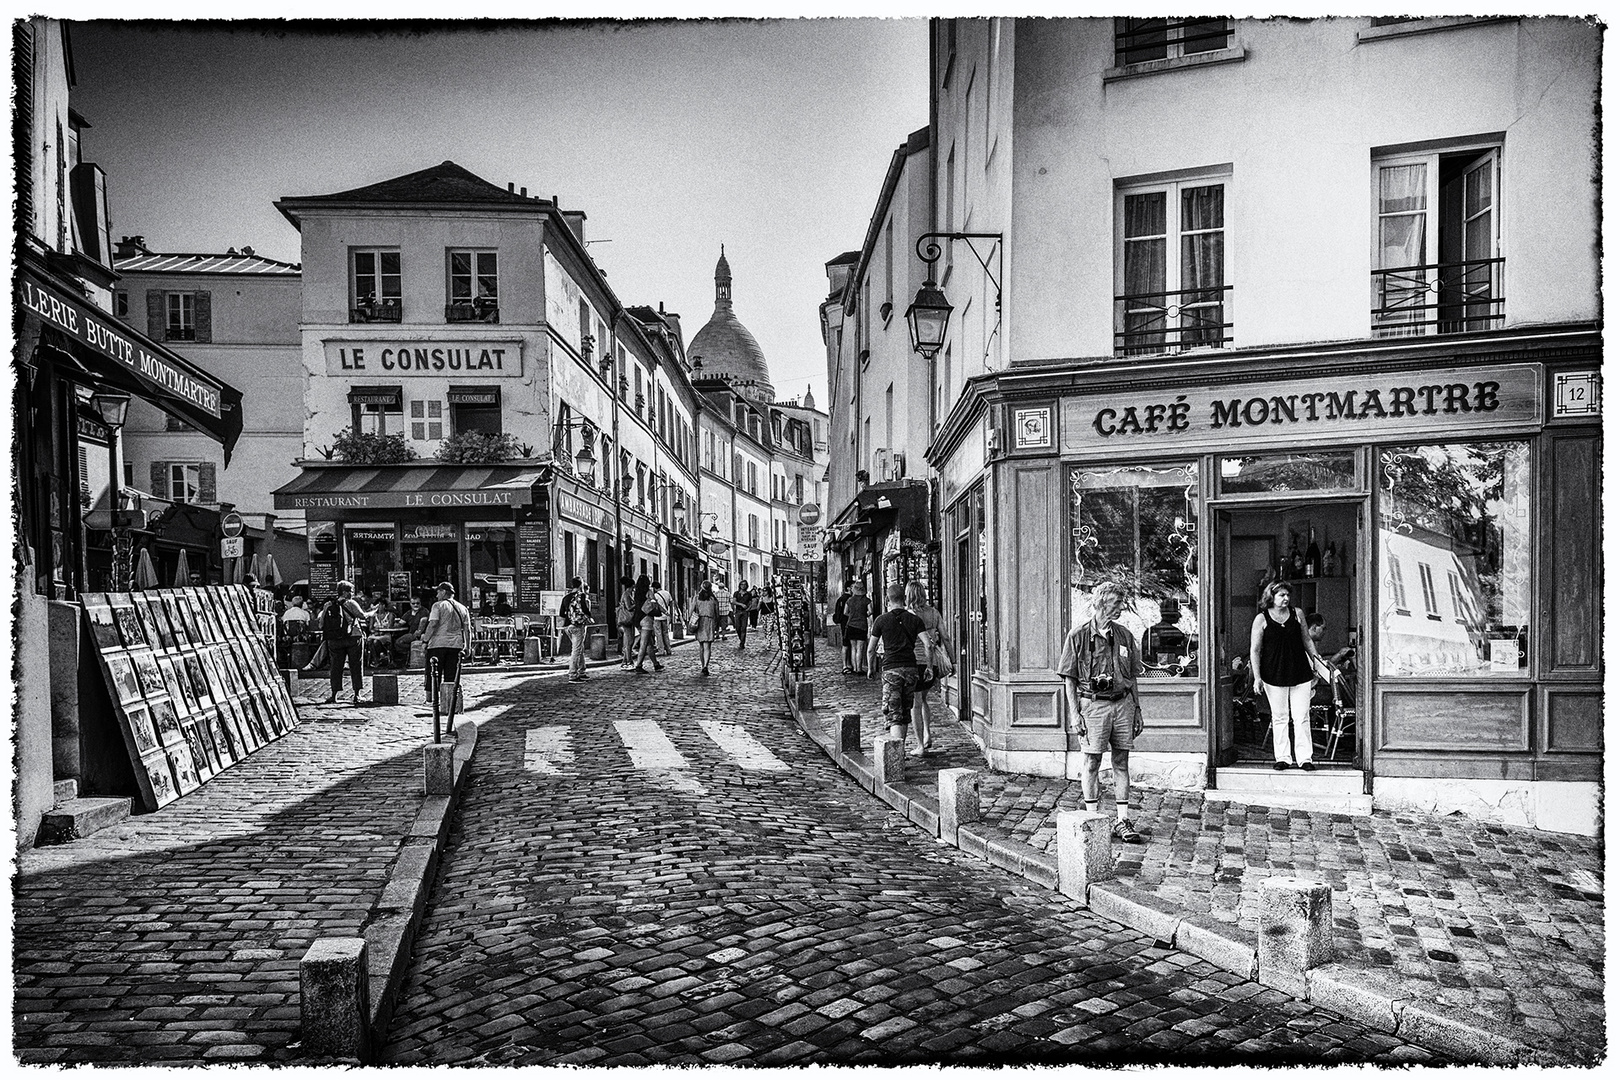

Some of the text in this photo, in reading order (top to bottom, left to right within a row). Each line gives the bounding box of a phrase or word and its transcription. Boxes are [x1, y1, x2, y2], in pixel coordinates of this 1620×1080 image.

[85, 317, 134, 366] BUTTE
[139, 350, 217, 412] MONTMARTRE
[340, 348, 506, 371] LE CONSULAT
[353, 395, 391, 403] RESTAURANT
[451, 394, 492, 403] LE CONSULAT
[1568, 386, 1585, 402] 12
[1092, 395, 1191, 438] CAFÉ
[1210, 381, 1501, 430] MONTMARTRE
[295, 496, 369, 507] RESTAURANT
[406, 492, 512, 506] LE CONSULAT
